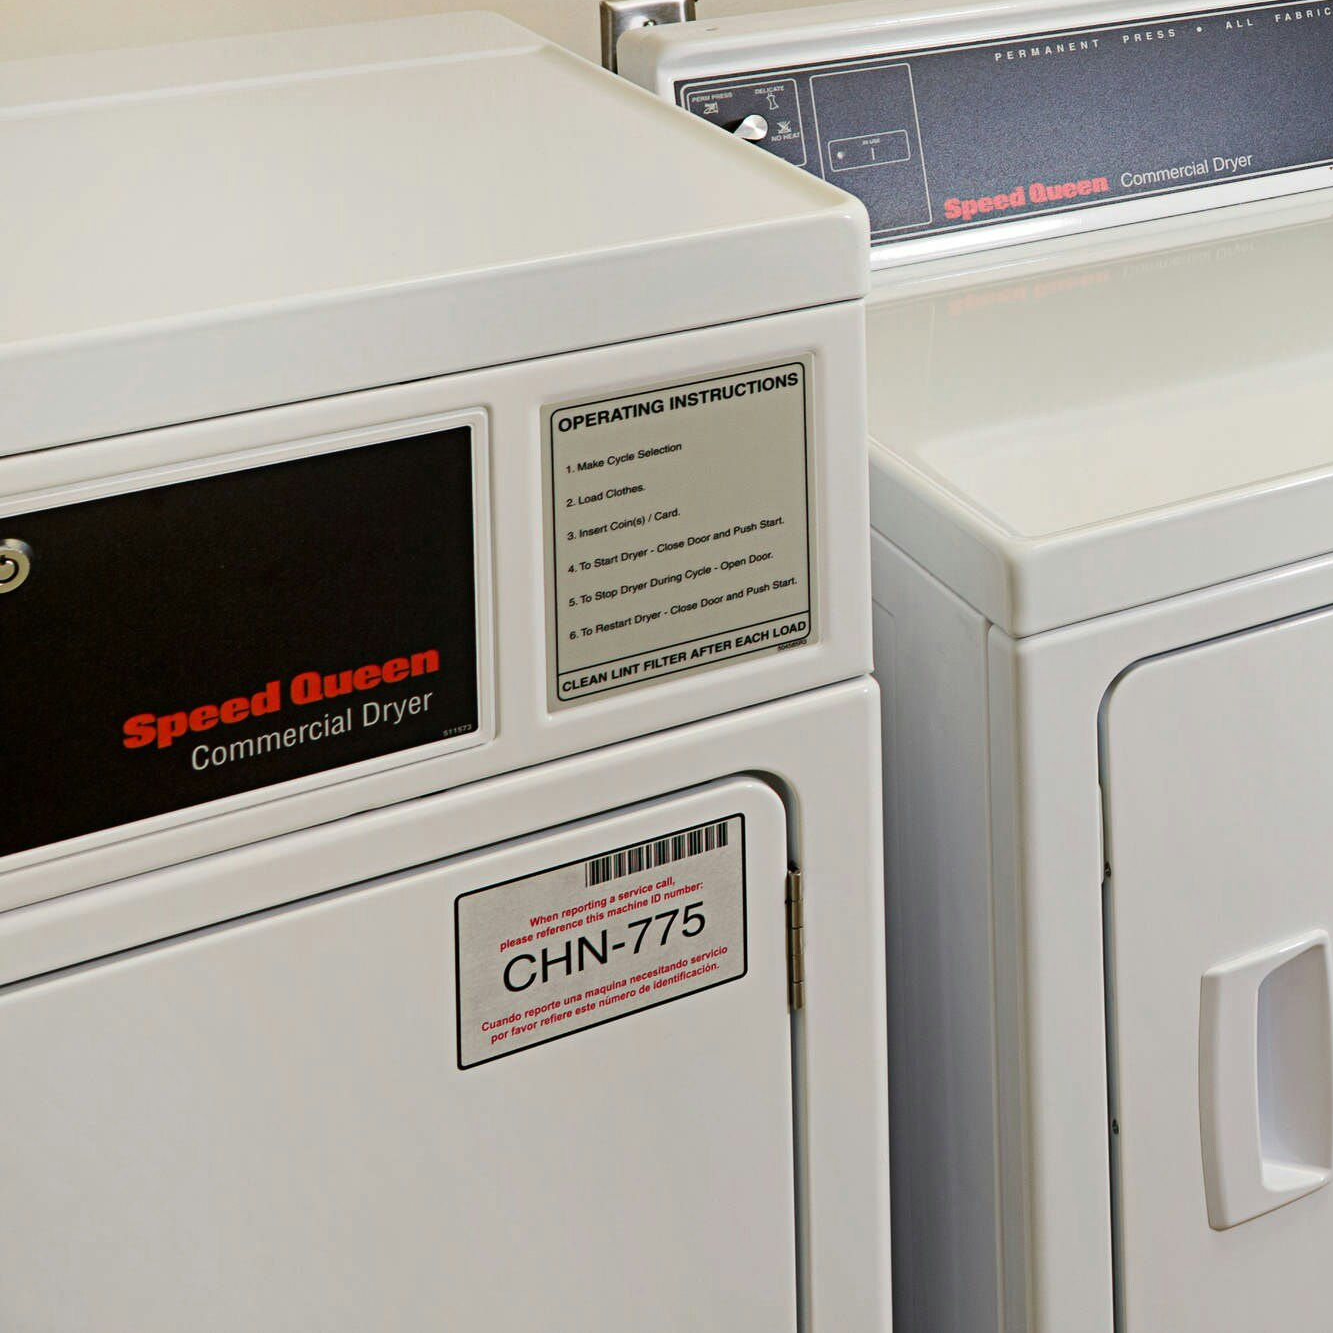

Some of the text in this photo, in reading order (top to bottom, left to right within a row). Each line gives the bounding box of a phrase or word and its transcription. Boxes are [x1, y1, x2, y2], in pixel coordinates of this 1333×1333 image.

[994, 7, 1333, 61] PERMANENT PRESS ALL FABRIC
[944, 151, 1253, 221] Speed Queen Commercial Dryer
[558, 372, 798, 432] OPERATING INSTRUCTIONS
[566, 443, 682, 474] 1. Make Cycle Selection
[566, 484, 646, 508] 2. Load Clothes.
[567, 508, 680, 541] 3. Insert Coin(s) Card.
[568, 516, 784, 573] 4. To Start Dryer Close Door and Push Start.
[569, 552, 773, 607] 5. To Stop Dryer During Cycle Open Door.
[569, 577, 797, 640] 6. To Restart Dryer Close Door and Push Start.
[562, 671, 608, 692] CLEAN
[611, 663, 640, 680] LINT
[643, 651, 687, 672] FILTER
[690, 640, 732, 659] AFTER
[735, 630, 769, 648] EACH
[773, 621, 808, 638] LOAD
[122, 649, 440, 748] Speed Queen
[191, 691, 433, 770] Commercial Dryer
[500, 882, 703, 952] please reference this machine ID number:
[529, 913, 559, 927] When
[561, 898, 607, 918] reporting
[618, 884, 653, 901] service
[655, 876, 675, 889] call,
[503, 901, 705, 992] CHN-775
[481, 946, 728, 1031] Cuando reporte una maquina necesitando servicio
[491, 963, 719, 1045] por favor refiere este número de identificación.
